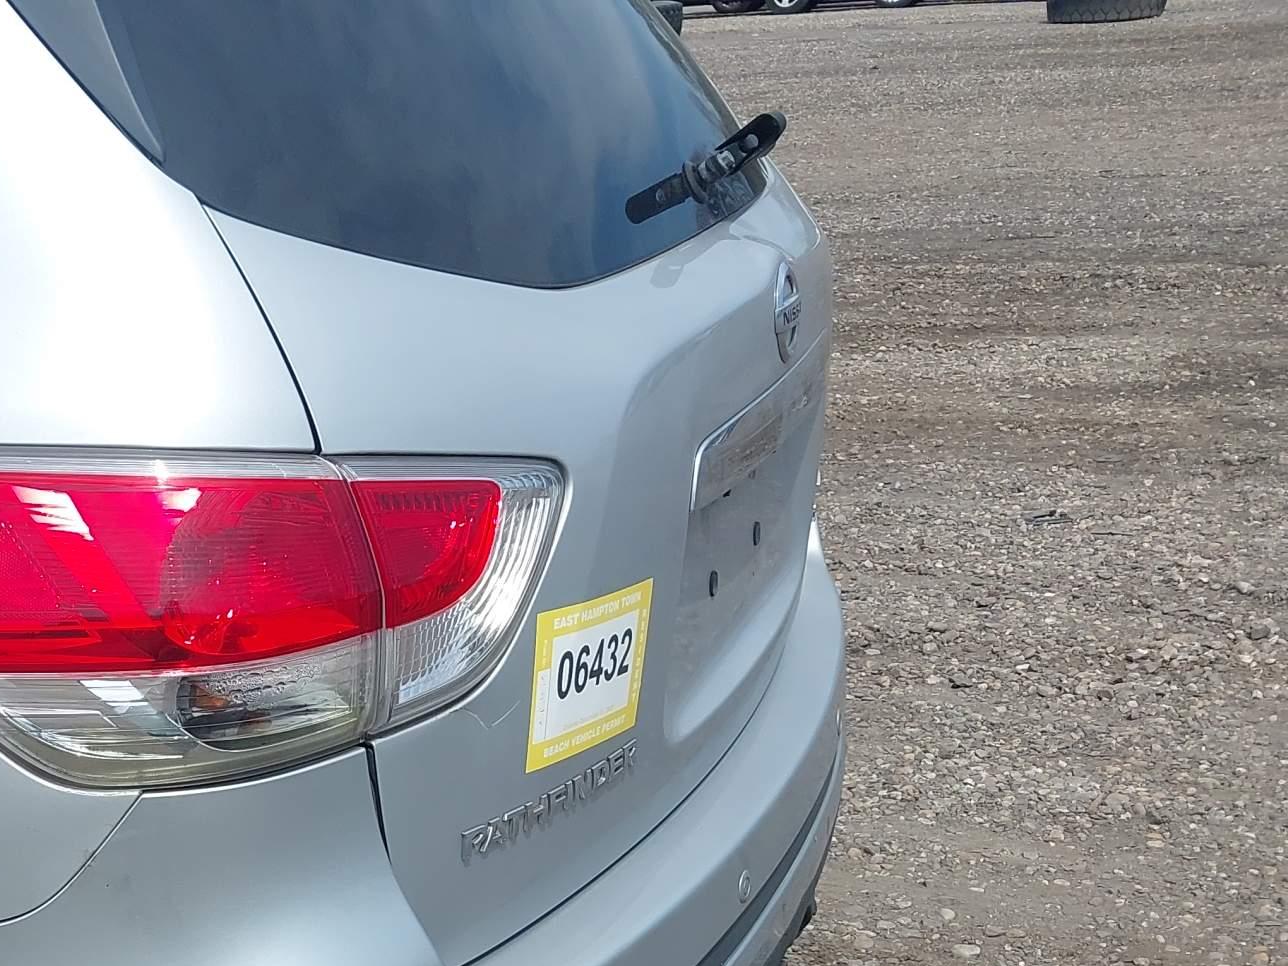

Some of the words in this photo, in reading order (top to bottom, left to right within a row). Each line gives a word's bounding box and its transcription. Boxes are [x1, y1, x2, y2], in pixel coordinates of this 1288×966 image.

[553, 613, 580, 630] EAST
[581, 600, 620, 622] HAMPTON
[557, 628, 632, 700] 06432
[544, 740, 569, 758] BEACH
[572, 727, 601, 747] VEHICLE
[462, 738, 637, 860] PATHFINDER
